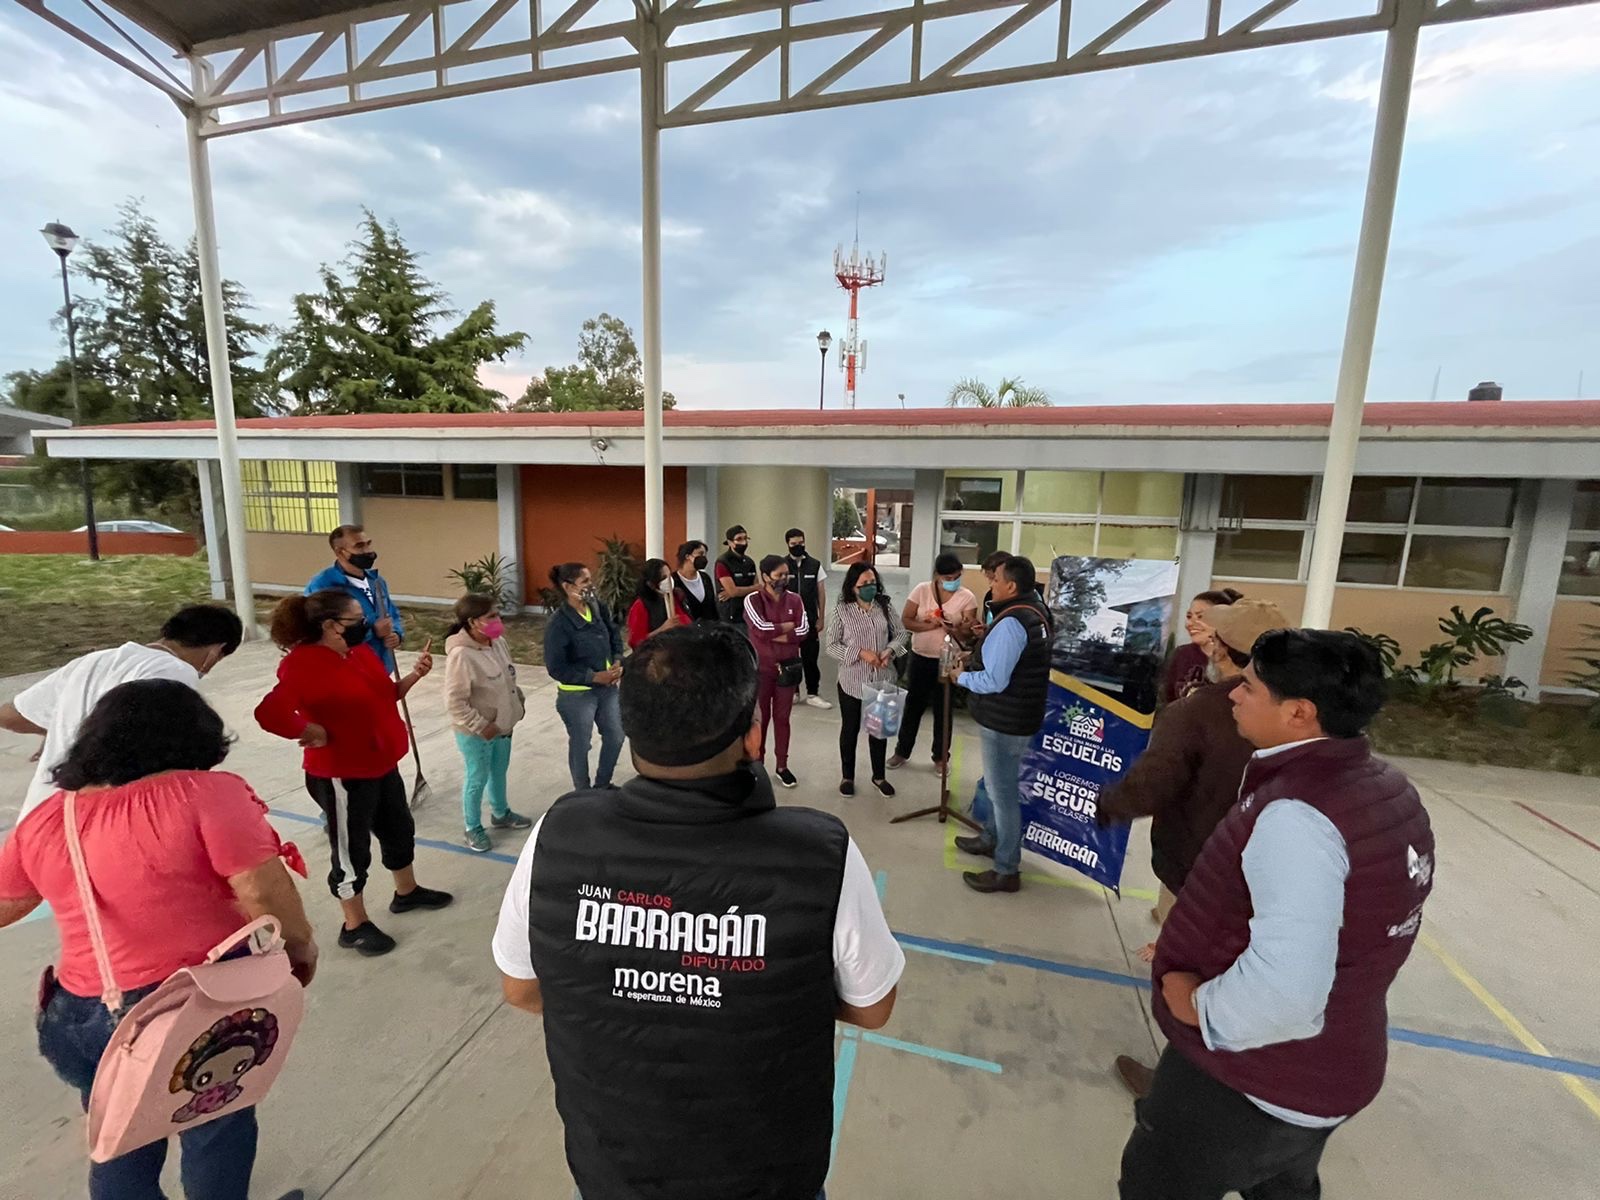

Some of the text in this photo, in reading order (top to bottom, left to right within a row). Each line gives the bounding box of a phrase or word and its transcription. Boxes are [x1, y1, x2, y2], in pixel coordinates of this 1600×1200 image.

[1042, 734, 1123, 772] ESCUELAS
[1036, 772, 1098, 801] UN RETOR
[1053, 769, 1101, 791] LOGREMOS
[1032, 782, 1097, 818] SEGUR
[1057, 806, 1090, 824] CLASES
[1025, 824, 1099, 869] BARRAGÁN
[577, 884, 673, 909] JUAN CARLOS
[575, 899, 767, 957] BARRAGÁN
[681, 954, 766, 972] DIPUTADO
[614, 967, 722, 997] morena
[612, 988, 721, 1008] La esperanza de México
